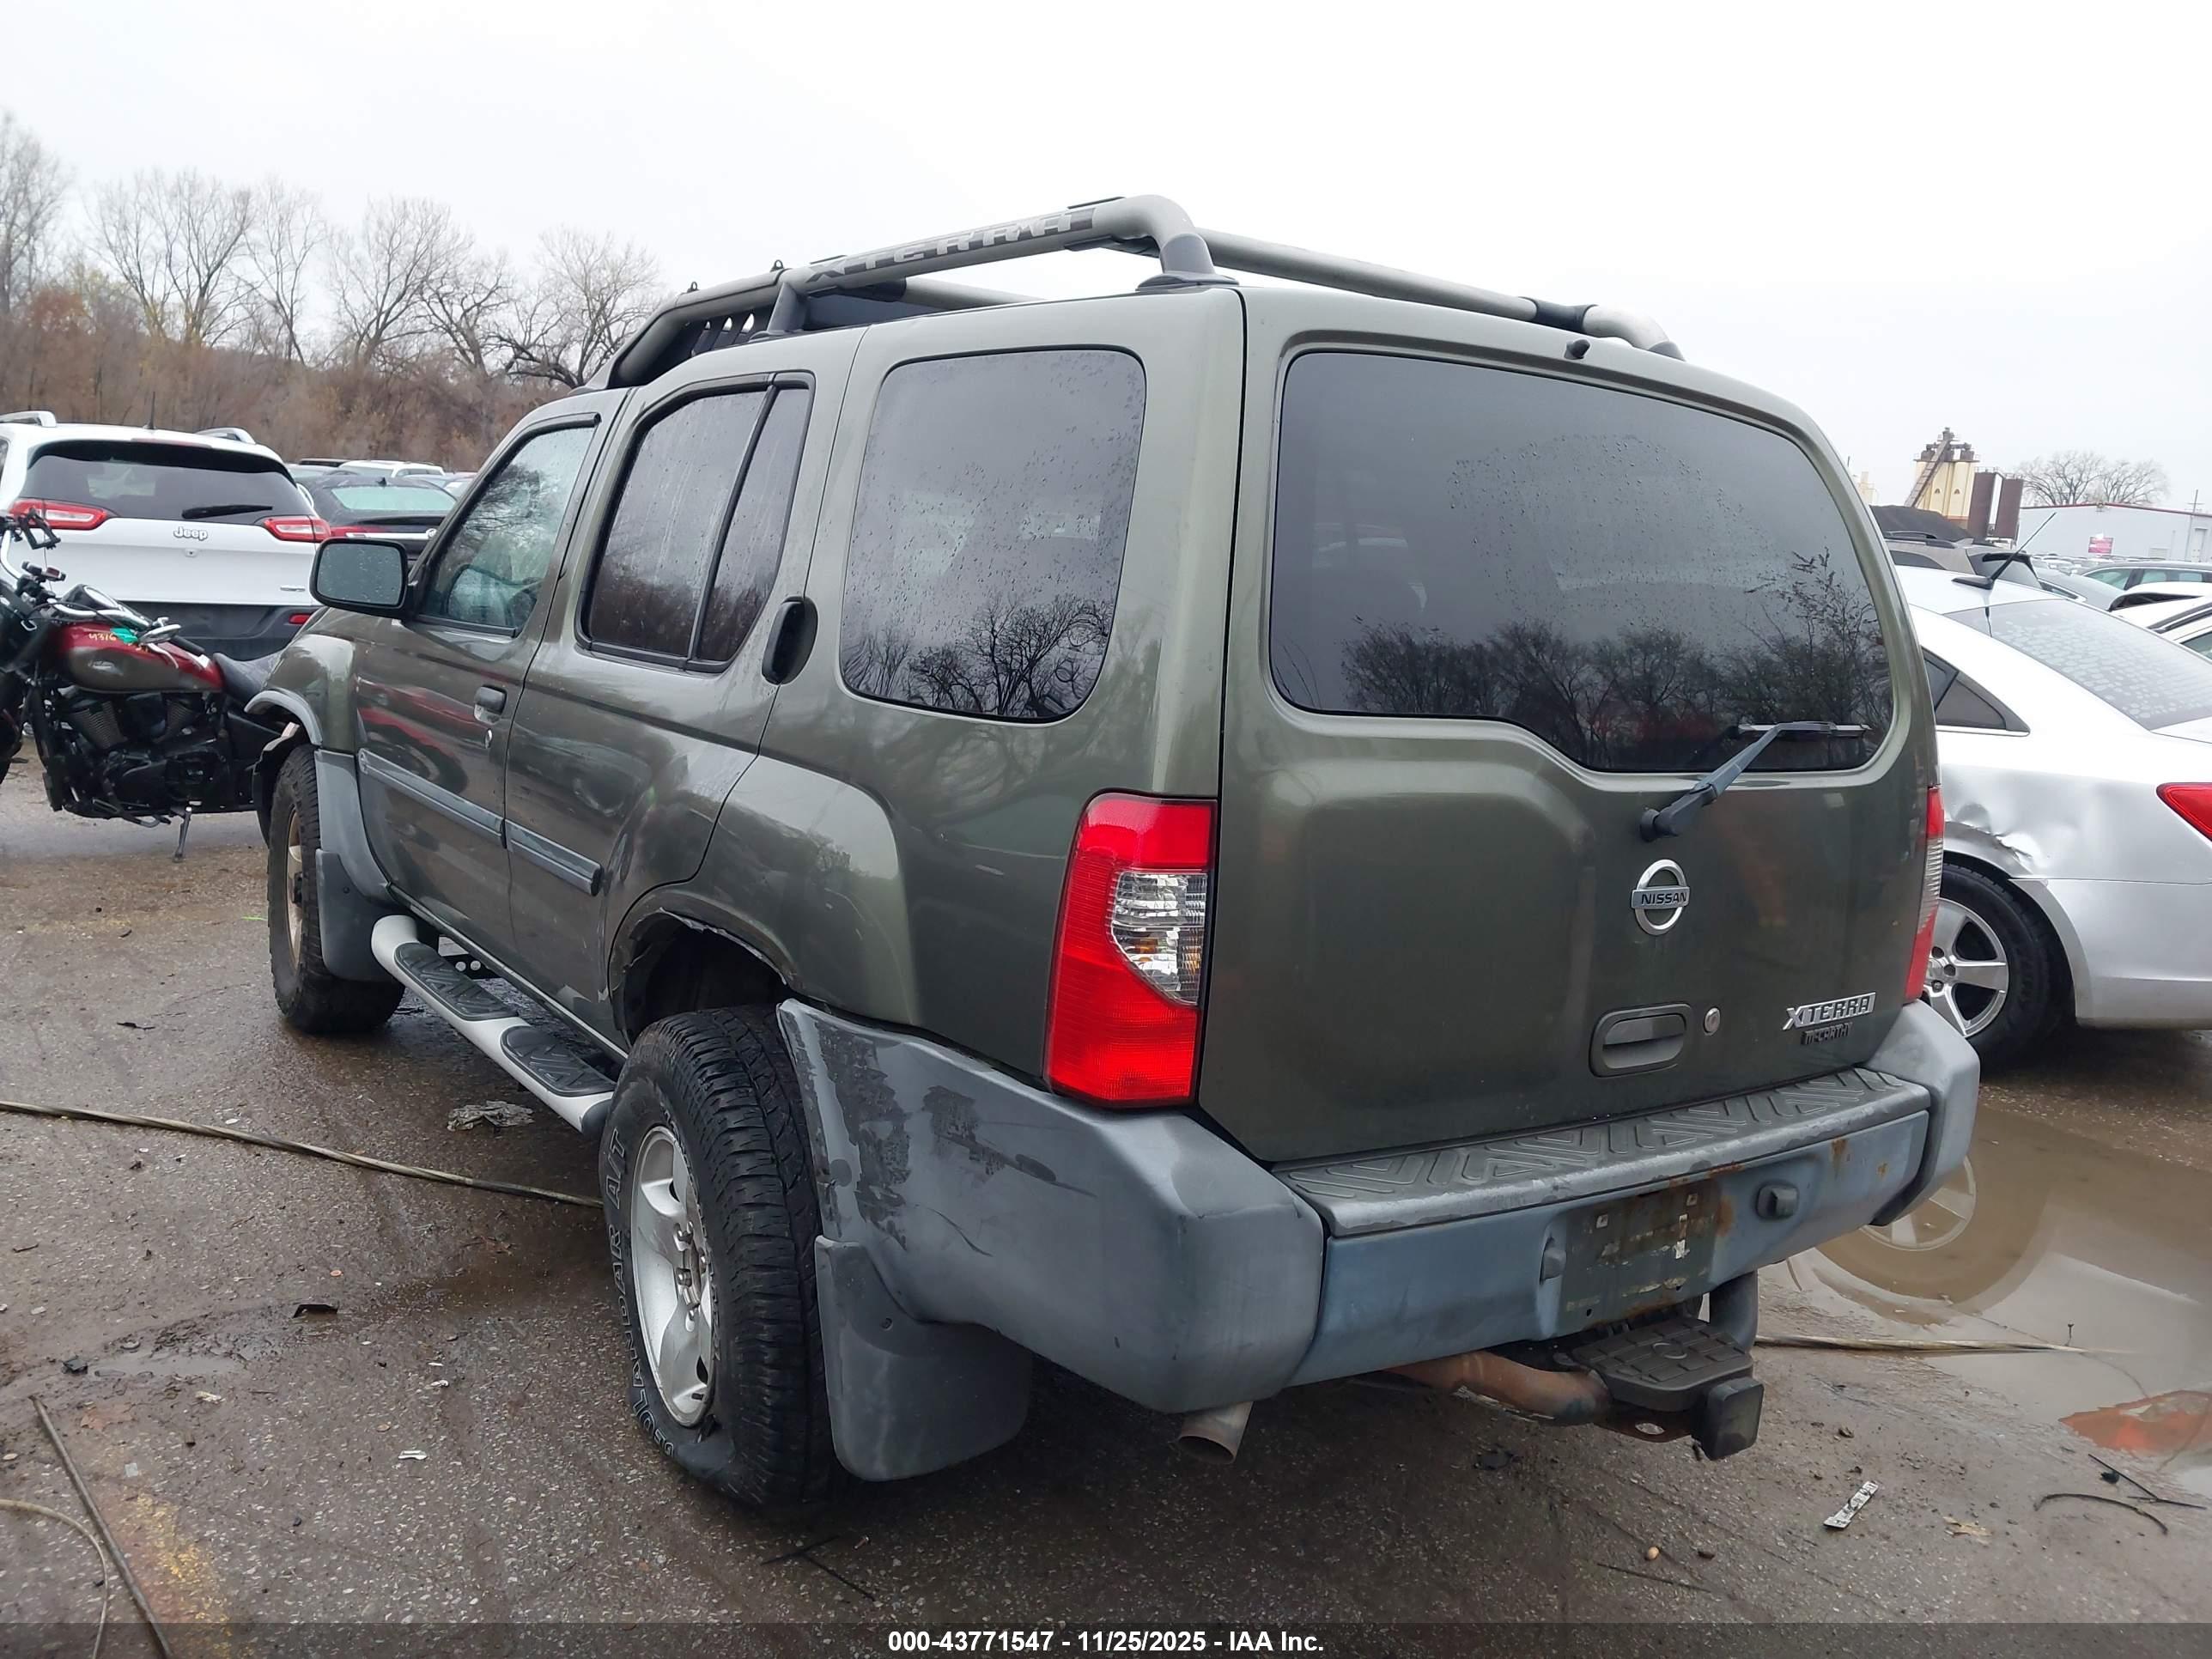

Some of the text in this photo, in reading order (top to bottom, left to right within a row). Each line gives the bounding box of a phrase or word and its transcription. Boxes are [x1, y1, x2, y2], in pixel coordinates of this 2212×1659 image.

[805, 210, 1084, 283] XTERRA
[173, 526, 209, 542] Jeep
[1641, 892, 1687, 905] NISSAN
[1783, 992, 1876, 1030] XTERRA
[606, 1127, 625, 1210] A/T
